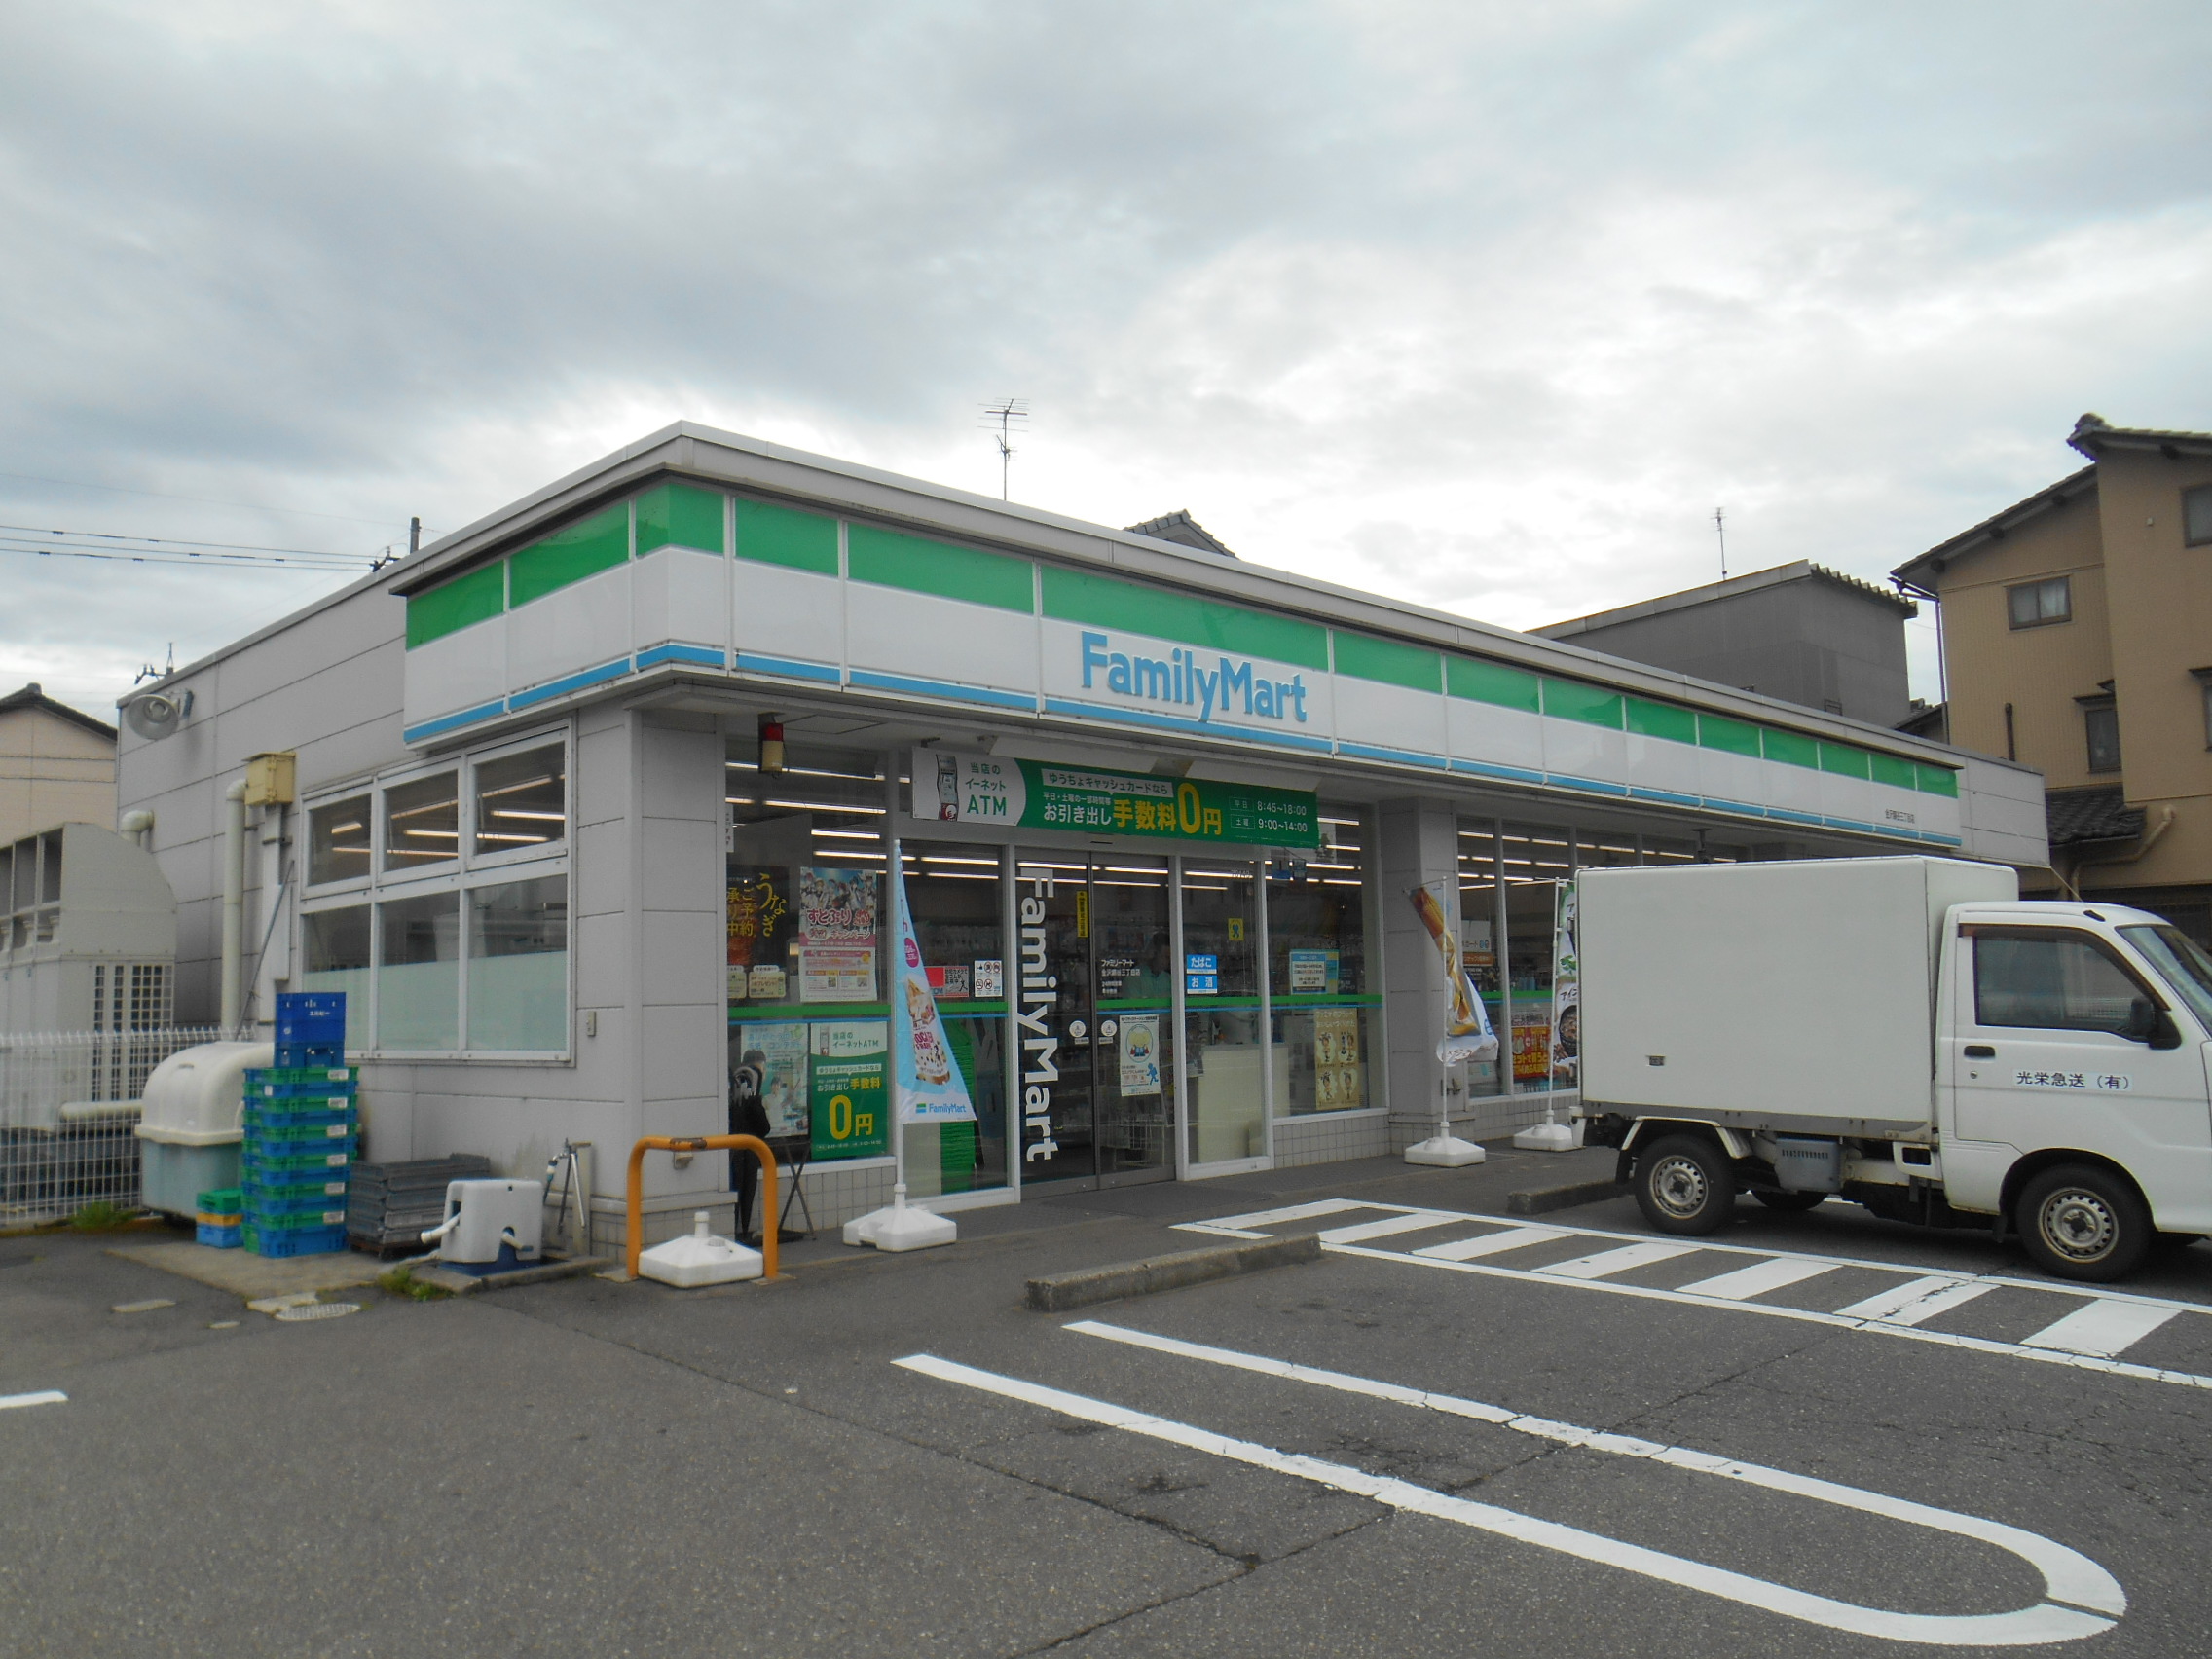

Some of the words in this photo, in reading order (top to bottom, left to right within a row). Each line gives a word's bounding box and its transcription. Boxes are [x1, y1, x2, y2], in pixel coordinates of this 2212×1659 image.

[1081, 630, 1308, 723] FamilyMart
[971, 762, 1001, 775] 当店の
[965, 778, 1007, 792] イーネット
[1049, 773, 1169, 794] ゆうちょキャッシュカードなら
[967, 794, 1008, 817] ATM
[756, 873, 787, 937] うなぎ
[1100, 959, 1135, 968] ファミリーマート
[1190, 955, 1213, 969] たばこ
[1017, 866, 1059, 1162] FamilyMart
[832, 1039, 880, 1048] イーネットATM
[2016, 1071, 2086, 1088] 光栄急送
[829, 1094, 873, 1140] 0円
[929, 1103, 967, 1114] FamilyMart
